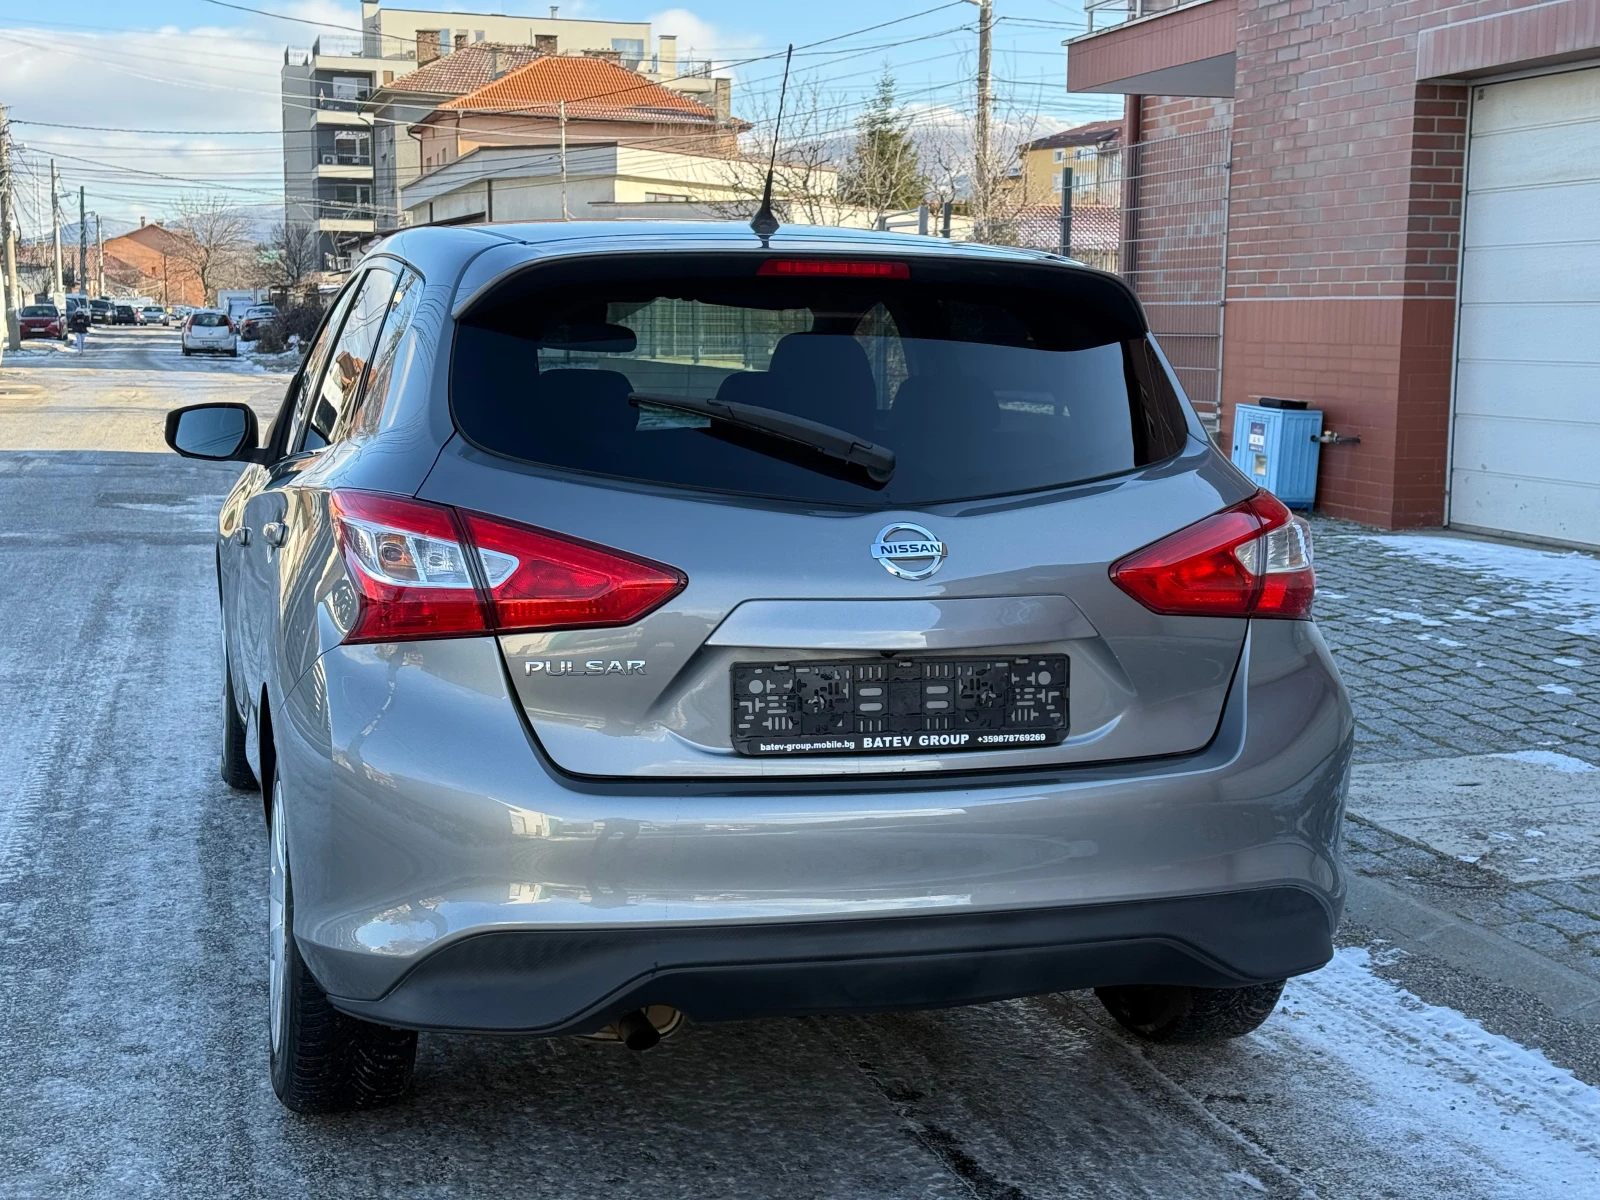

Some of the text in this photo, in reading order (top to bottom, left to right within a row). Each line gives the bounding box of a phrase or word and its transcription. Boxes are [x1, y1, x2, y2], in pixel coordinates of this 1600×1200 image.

[880, 543, 941, 554] NISSAN
[524, 660, 647, 676] PULSAR
[760, 733, 1046, 751] batev-group.mobile.bg BATEV GROUP +359878769269
